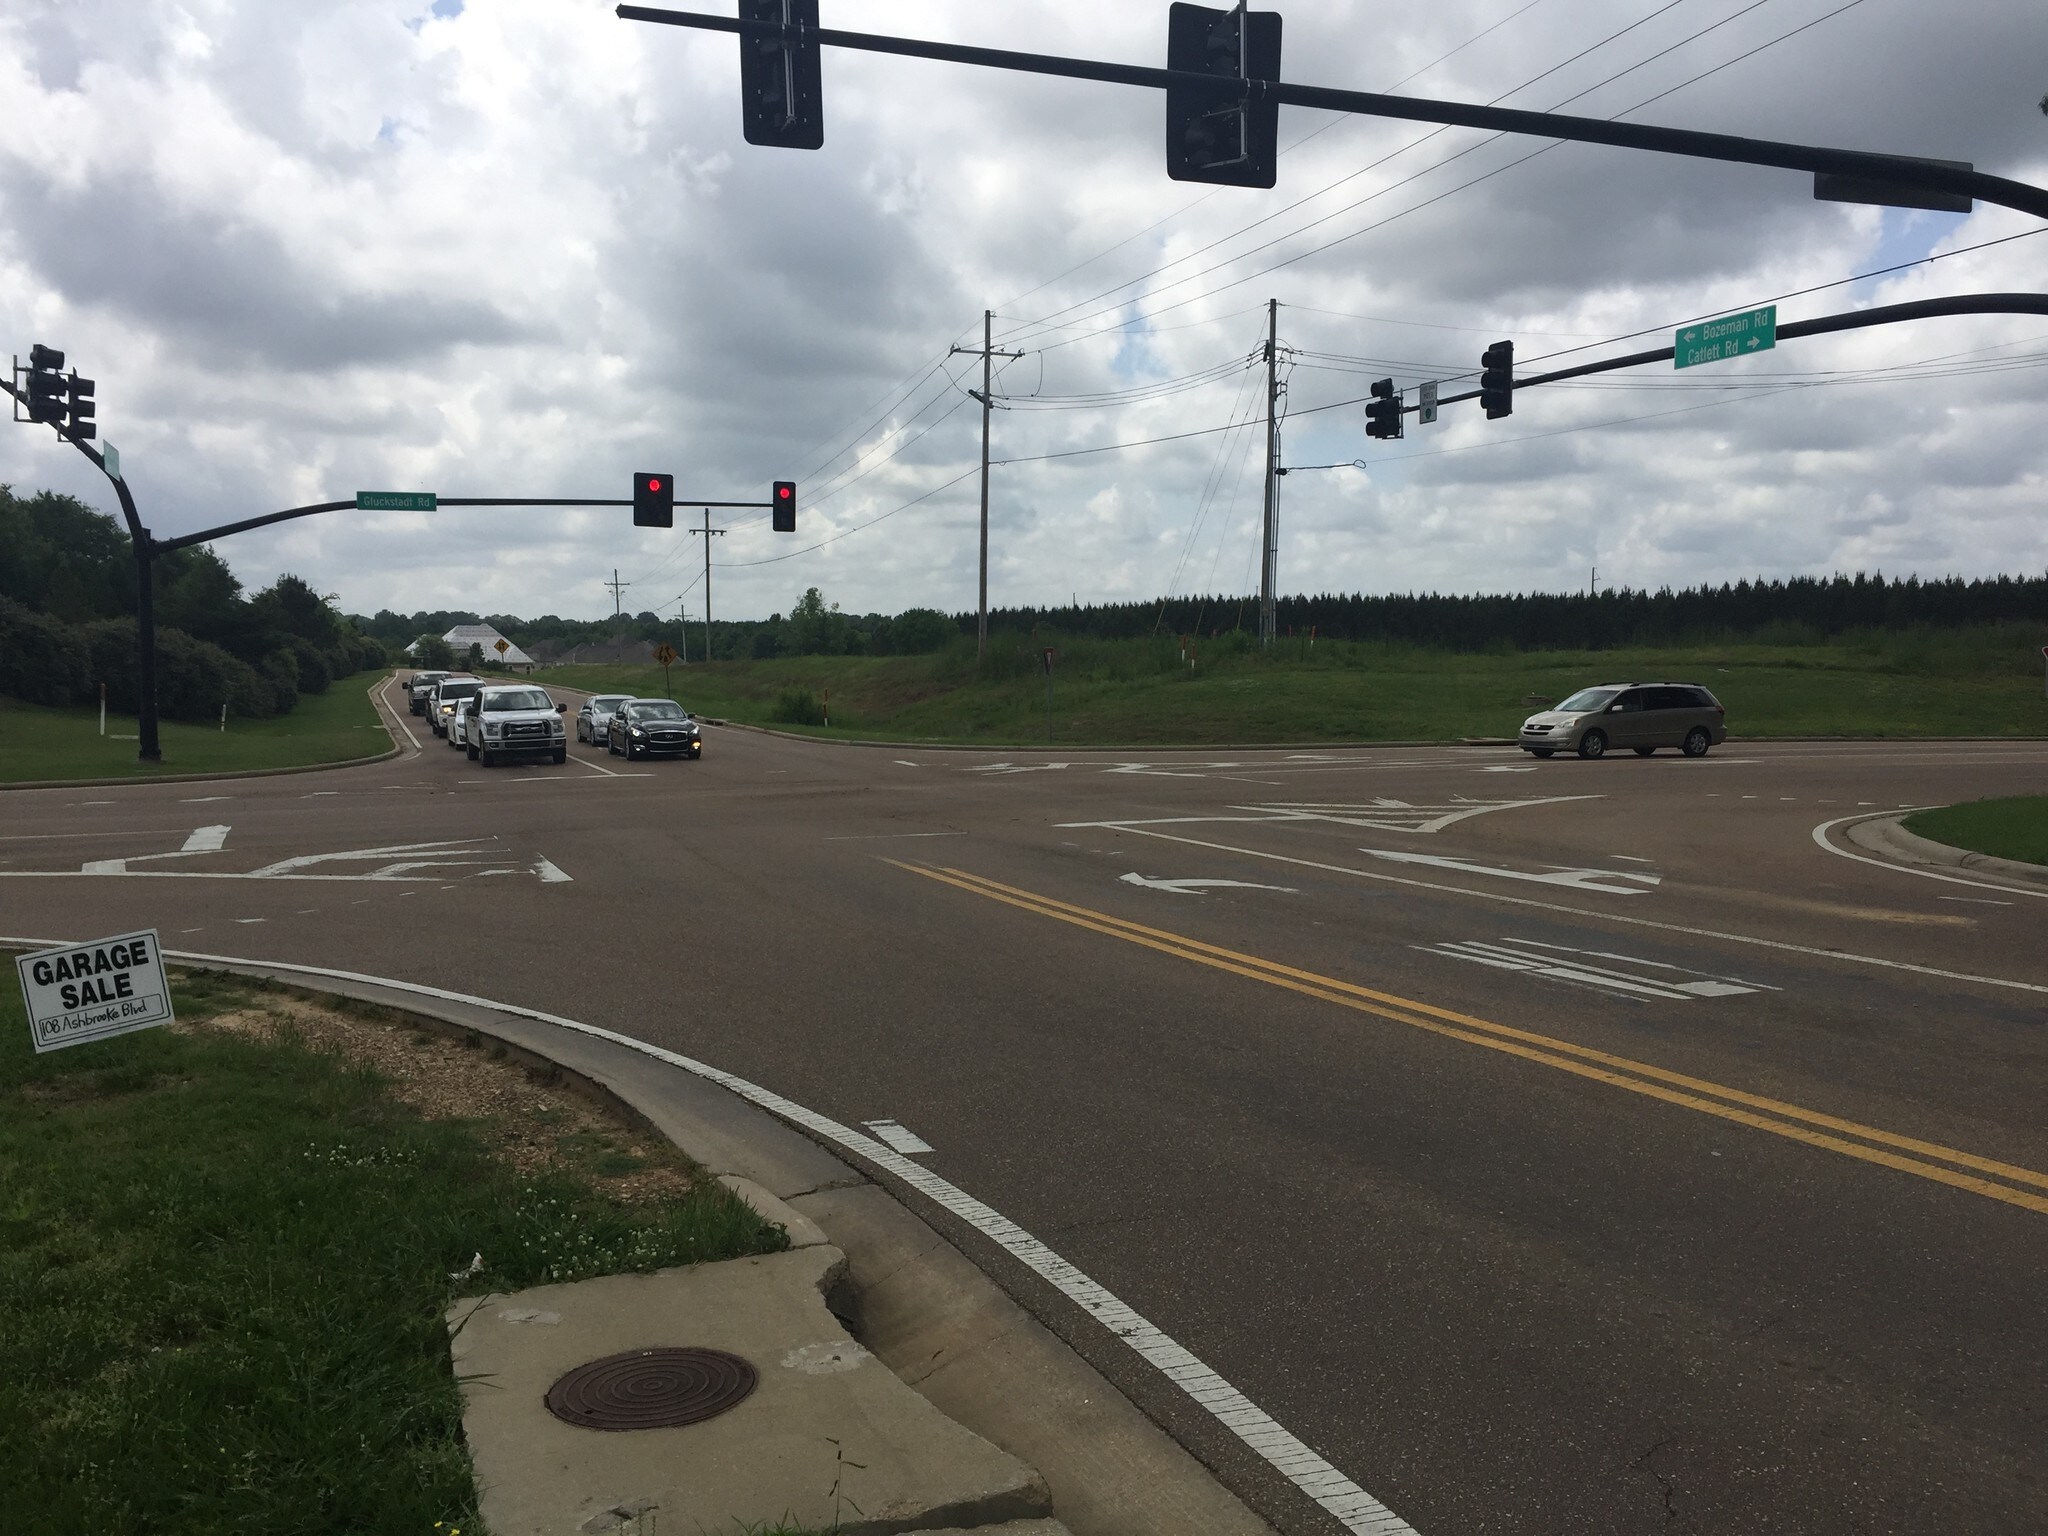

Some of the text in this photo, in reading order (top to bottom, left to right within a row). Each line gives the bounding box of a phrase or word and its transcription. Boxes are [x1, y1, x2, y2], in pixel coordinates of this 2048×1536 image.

[1703, 311, 1768, 339] Bozeman Rd
[1688, 340, 1738, 363] Catlett Rd
[364, 496, 430, 507] Gluckstadt Rd
[32, 940, 149, 986] GARAGE
[60, 973, 134, 1010] SALE
[42, 999, 148, 1036] 108 Ashbrooke Blvd
